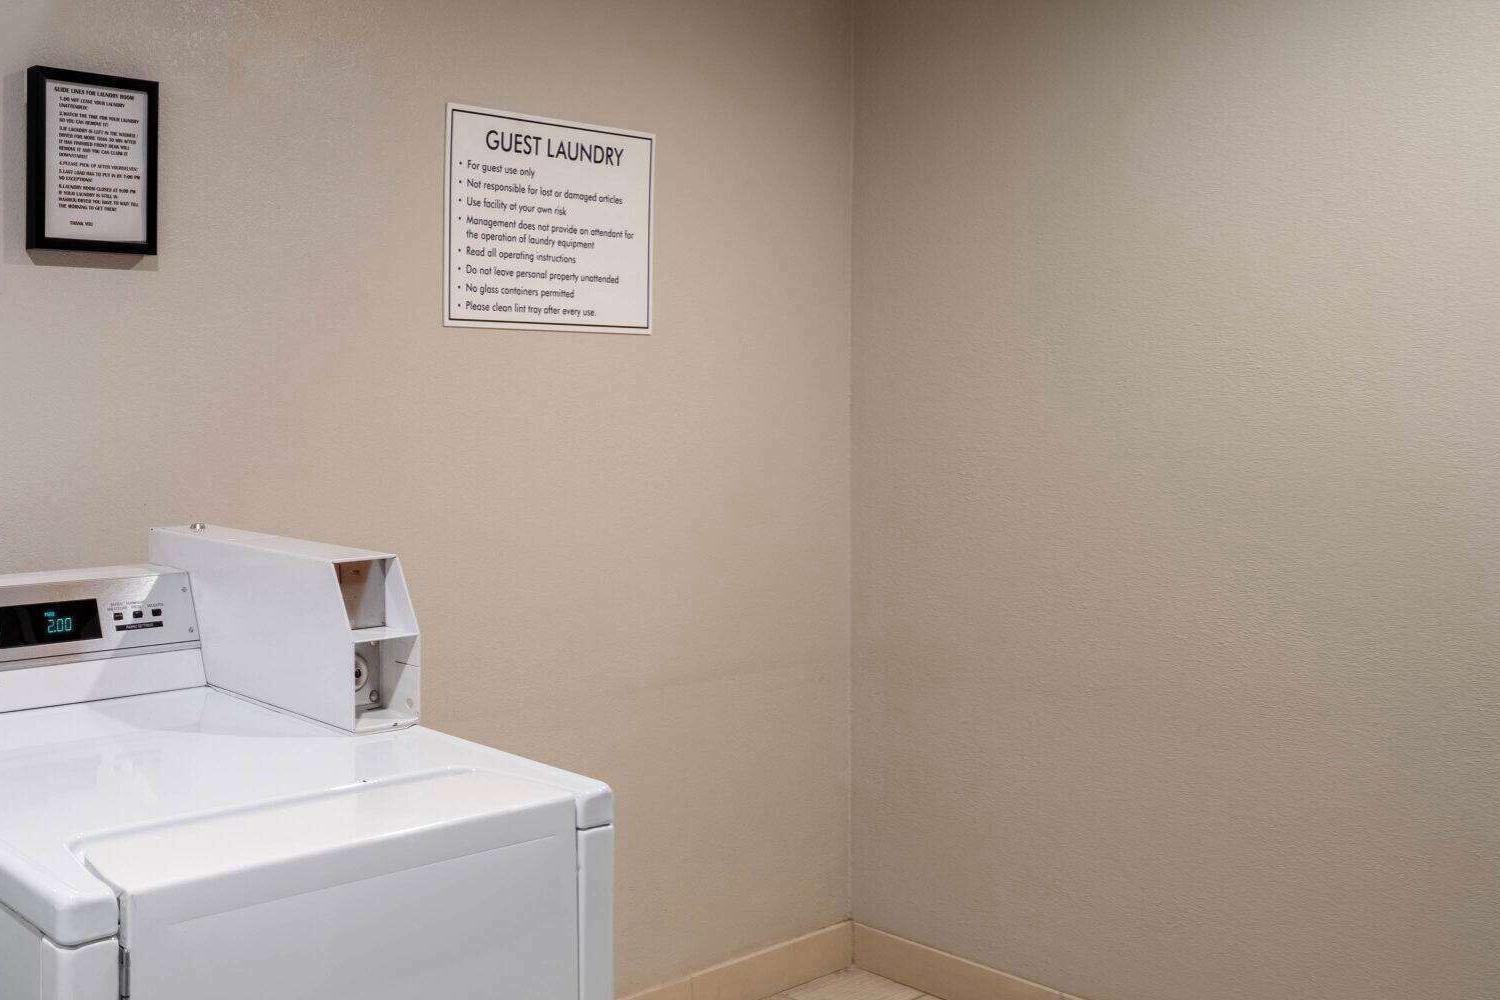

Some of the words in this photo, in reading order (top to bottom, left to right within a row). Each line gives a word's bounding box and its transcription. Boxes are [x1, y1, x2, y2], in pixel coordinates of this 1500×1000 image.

[486, 130, 542, 156] GUEST
[547, 138, 624, 166] LAUNDRY
[467, 160, 479, 170] For
[482, 162, 502, 174] guest
[505, 166, 517, 175] use
[520, 167, 535, 179] only
[467, 179, 481, 189] Not
[484, 181, 525, 194] responsible
[528, 185, 538, 195] for
[540, 187, 552, 197] lost
[555, 190, 562, 198] or
[564, 189, 597, 204] damaged
[599, 194, 623, 205] articles
[467, 197, 480, 207] Use
[484, 199, 507, 212] facility
[510, 202, 517, 211] at
[519, 205, 535, 215] your
[537, 206, 552, 215] own
[555, 206, 566, 216] risk
[467, 216, 516, 231] Management
[519, 220, 535, 231] does
[538, 223, 549, 232] not
[551, 224, 578, 236] provide
[580, 228, 589, 236] an
[591, 227, 623, 240] attendant
[625, 229, 634, 240] for
[466, 230, 478, 240] the
[481, 232, 516, 247] operation
[519, 235, 527, 244] of
[528, 236, 555, 248] laundry
[558, 240, 595, 252] equipment
[467, 247, 484, 256] Read
[487, 248, 497, 258] all
[500, 251, 534, 262] operating
[537, 254, 576, 264] instructions
[466, 265, 477, 274] Do
[480, 266, 491, 275] not
[494, 267, 514, 277] leave
[516, 270, 547, 282] personal
[550, 273, 579, 283] property
[581, 274, 619, 284] unattended
[466, 283, 478, 292] No
[480, 285, 499, 296] glass
[501, 286, 538, 297] containers
[541, 289, 575, 300] permitted
[466, 302, 489, 311] Please
[492, 302, 512, 312] clean
[515, 303, 526, 313] lint
[528, 305, 542, 315] tray
[544, 304, 560, 315] after
[563, 307, 581, 317] every
[583, 308, 596, 317] use.
[47, 618, 72, 633] 2.00
